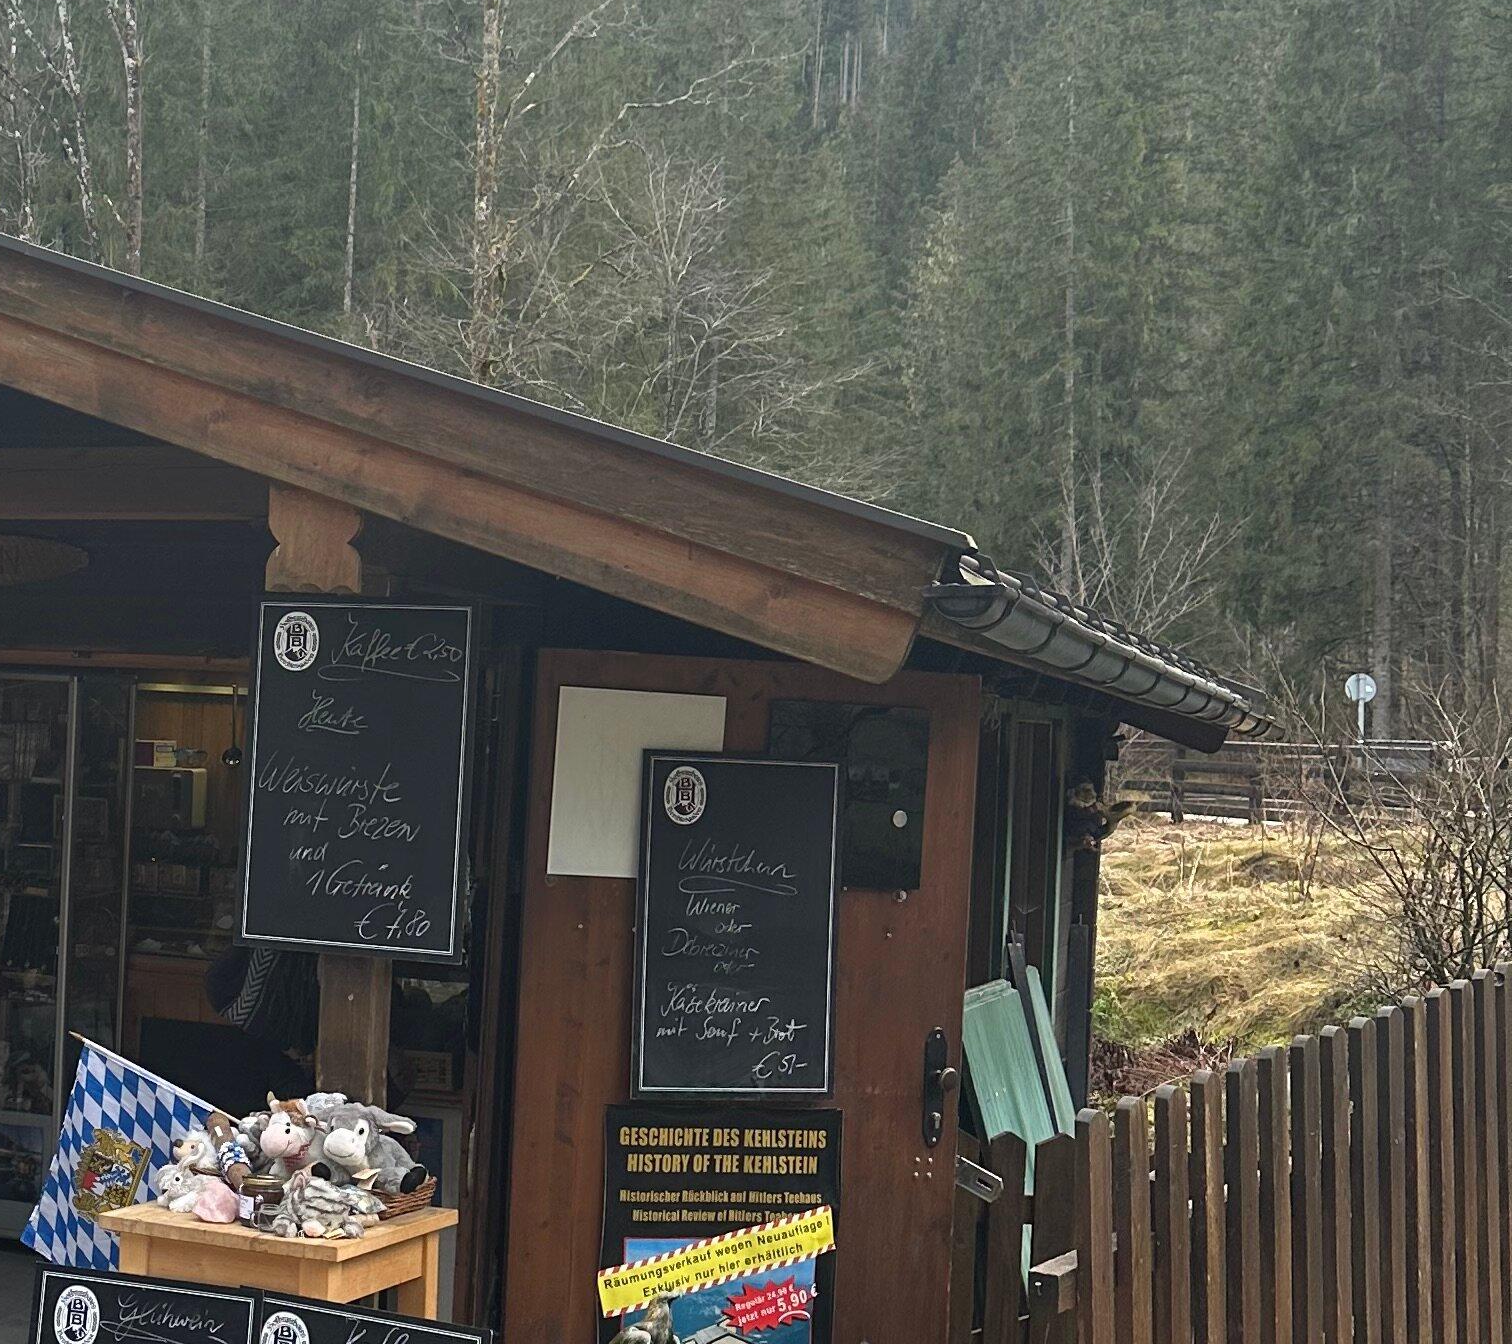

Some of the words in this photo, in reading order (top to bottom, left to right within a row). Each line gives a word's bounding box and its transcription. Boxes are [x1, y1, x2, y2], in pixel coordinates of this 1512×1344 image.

[331, 612, 402, 672] Kaffee
[283, 799, 329, 833] mit
[338, 803, 421, 842] Brezen
[289, 842, 329, 862] und
[686, 893, 741, 917] Wiener
[714, 918, 753, 935] oder
[656, 1017, 688, 1038] mit
[695, 1016, 742, 1047] Senf
[763, 1016, 808, 1045] Brot
[619, 1126, 710, 1147] GESCHICHTE
[712, 1127, 740, 1148] DES
[743, 1129, 827, 1149] KEHLSTEINS
[627, 1154, 690, 1174] HISTORY
[692, 1154, 711, 1174] OF
[713, 1154, 740, 1174] THE
[743, 1155, 818, 1175] KEHLSTEIN
[619, 1189, 680, 1204] Historischer
[681, 1189, 729, 1204] Rückblick
[730, 1190, 746, 1204] auf
[748, 1190, 782, 1205] Hitlers
[784, 1191, 823, 1205] Teehaus
[632, 1209, 680, 1224] Historical
[681, 1209, 715, 1223] Review
[717, 1209, 728, 1223] of
[728, 1209, 763, 1224] Hitlers
[603, 1251, 712, 1290] Räumungsverkauf
[714, 1238, 753, 1260] wegen
[756, 1219, 824, 1247] Neuauflage
[642, 1274, 692, 1298] Exklusiv
[694, 1268, 716, 1282] nur
[718, 1259, 741, 1275] hier
[744, 1242, 804, 1267] erhältlich
[760, 1305, 776, 1317] nur
[776, 1289, 808, 1312] 5,90
